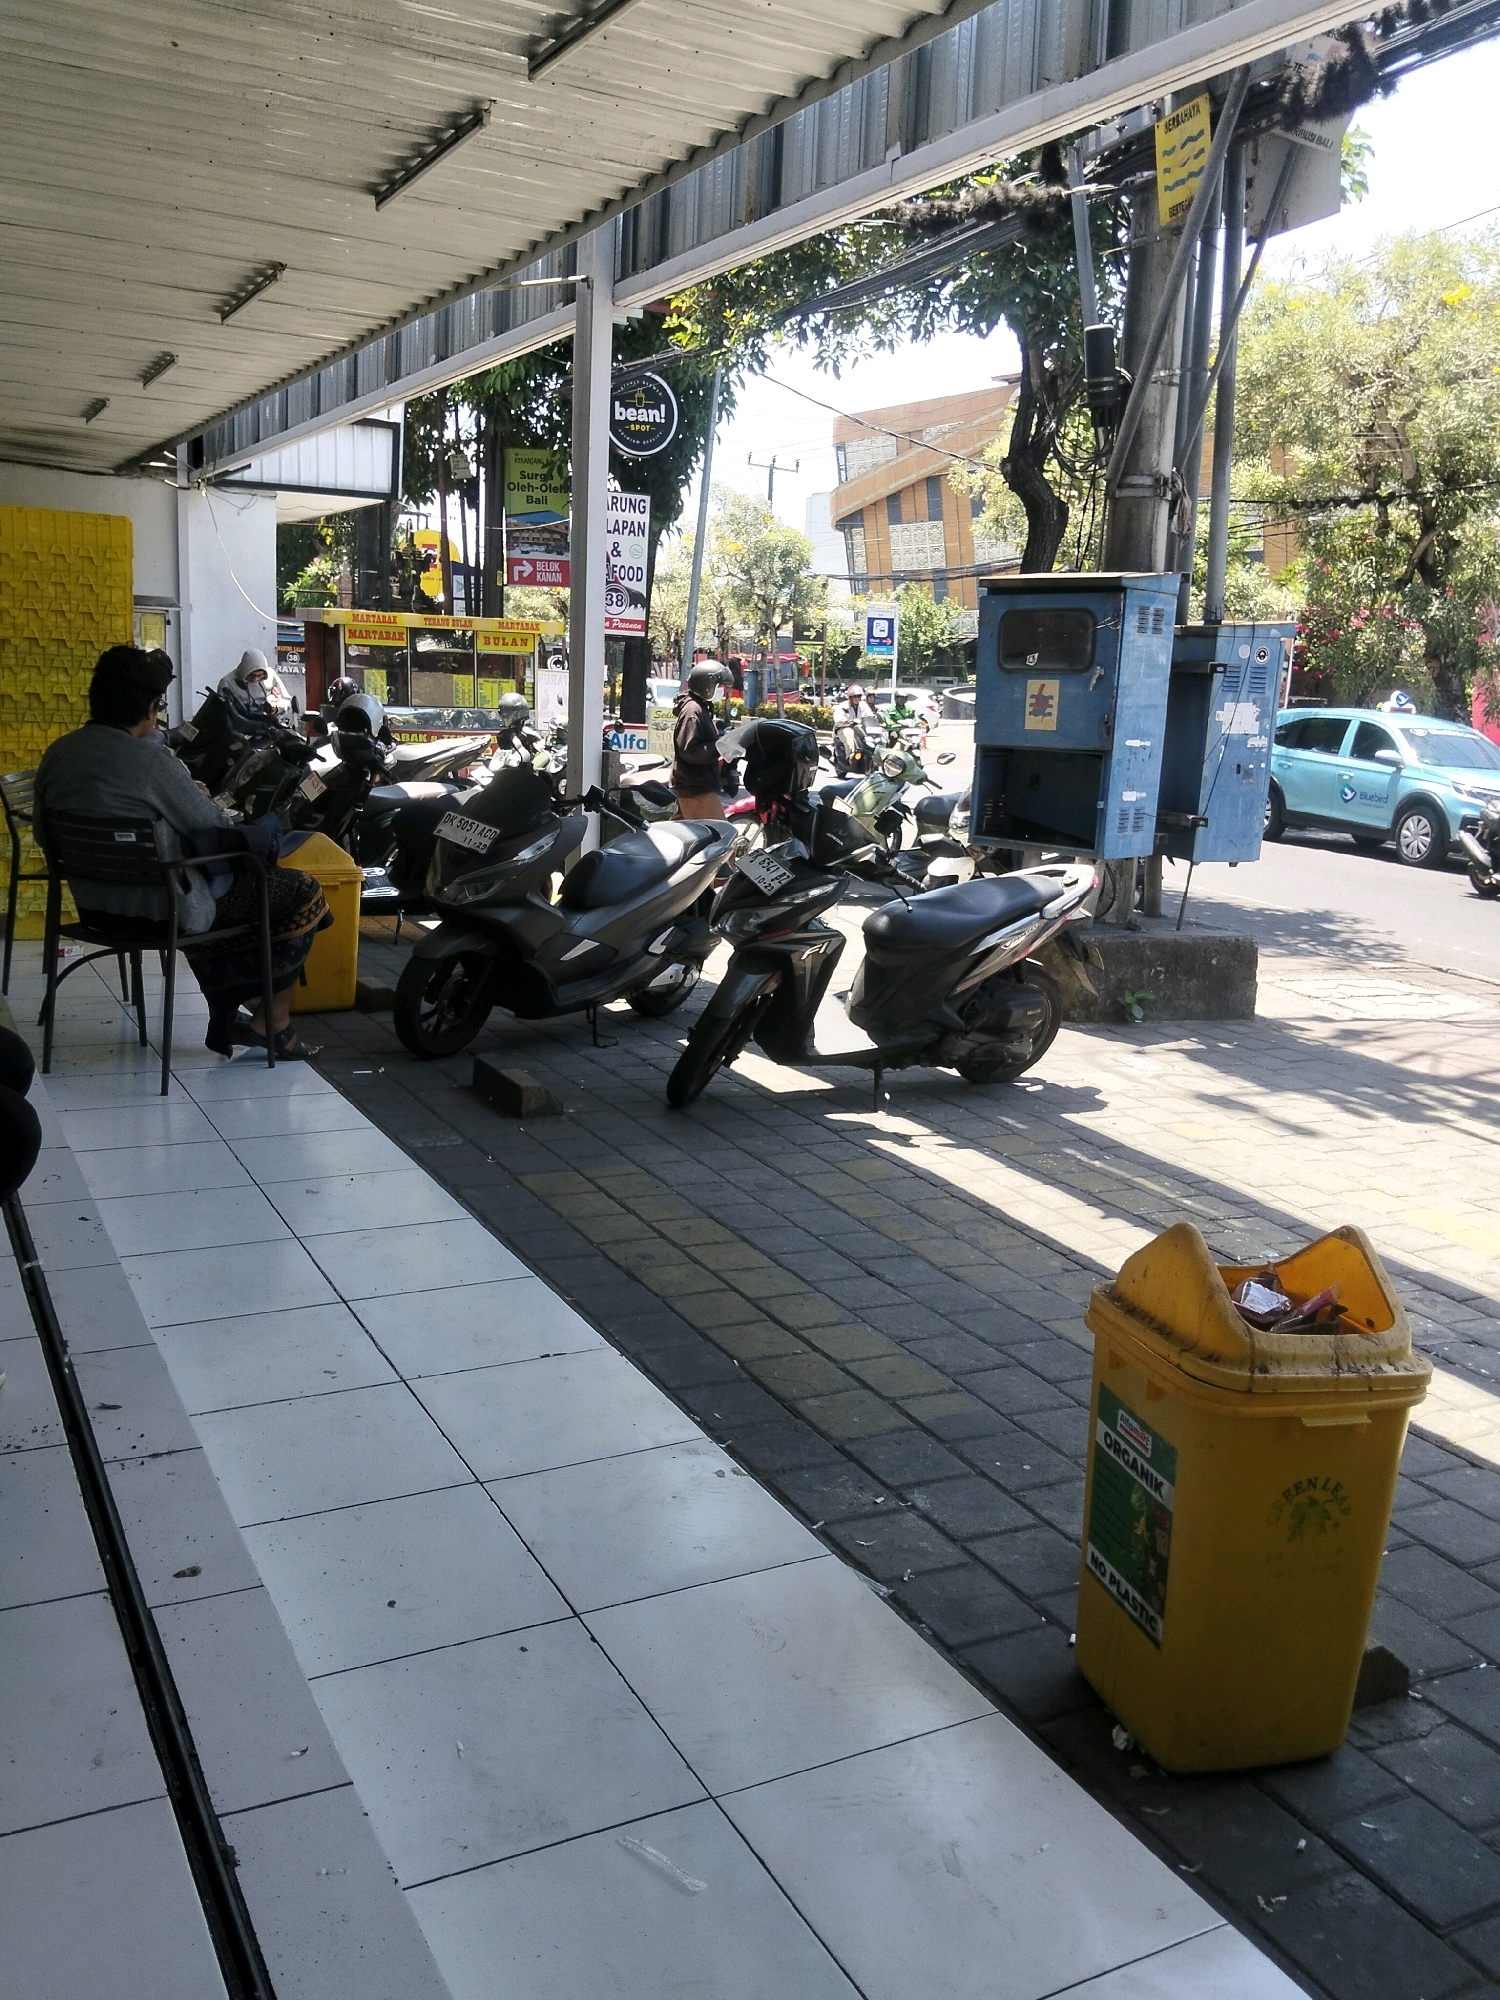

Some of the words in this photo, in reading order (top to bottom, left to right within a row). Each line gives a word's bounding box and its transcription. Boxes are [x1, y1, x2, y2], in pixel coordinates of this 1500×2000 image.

[1316, 135, 1334, 150] BALI
[614, 400, 666, 423] bean!
[630, 424, 650, 432] SPOT
[525, 495, 548, 505] Bali
[611, 541, 622, 558] &
[536, 561, 560, 572] BELOK
[536, 572, 562, 583] KANAN
[606, 593, 624, 607] 38
[352, 613, 398, 625] MARTABAK
[424, 617, 450, 627] TERANG
[452, 619, 474, 628] BULAN
[612, 618, 642, 630] Pesanan
[498, 621, 540, 632] MARTABAK
[348, 628, 405, 642] MARTABAK
[483, 636, 528, 647] BULAN
[610, 731, 647, 751] Alfa
[1359, 791, 1389, 805] Bluebird
[444, 812, 459, 827] DK
[456, 817, 480, 834] 5051
[758, 857, 781, 874] 6541
[1118, 1412, 1151, 1447] Alfamart
[1103, 1430, 1164, 1500] ORGANIK
[1090, 1550, 1107, 1577] NO
[1108, 1573, 1158, 1634] PLASTIC
